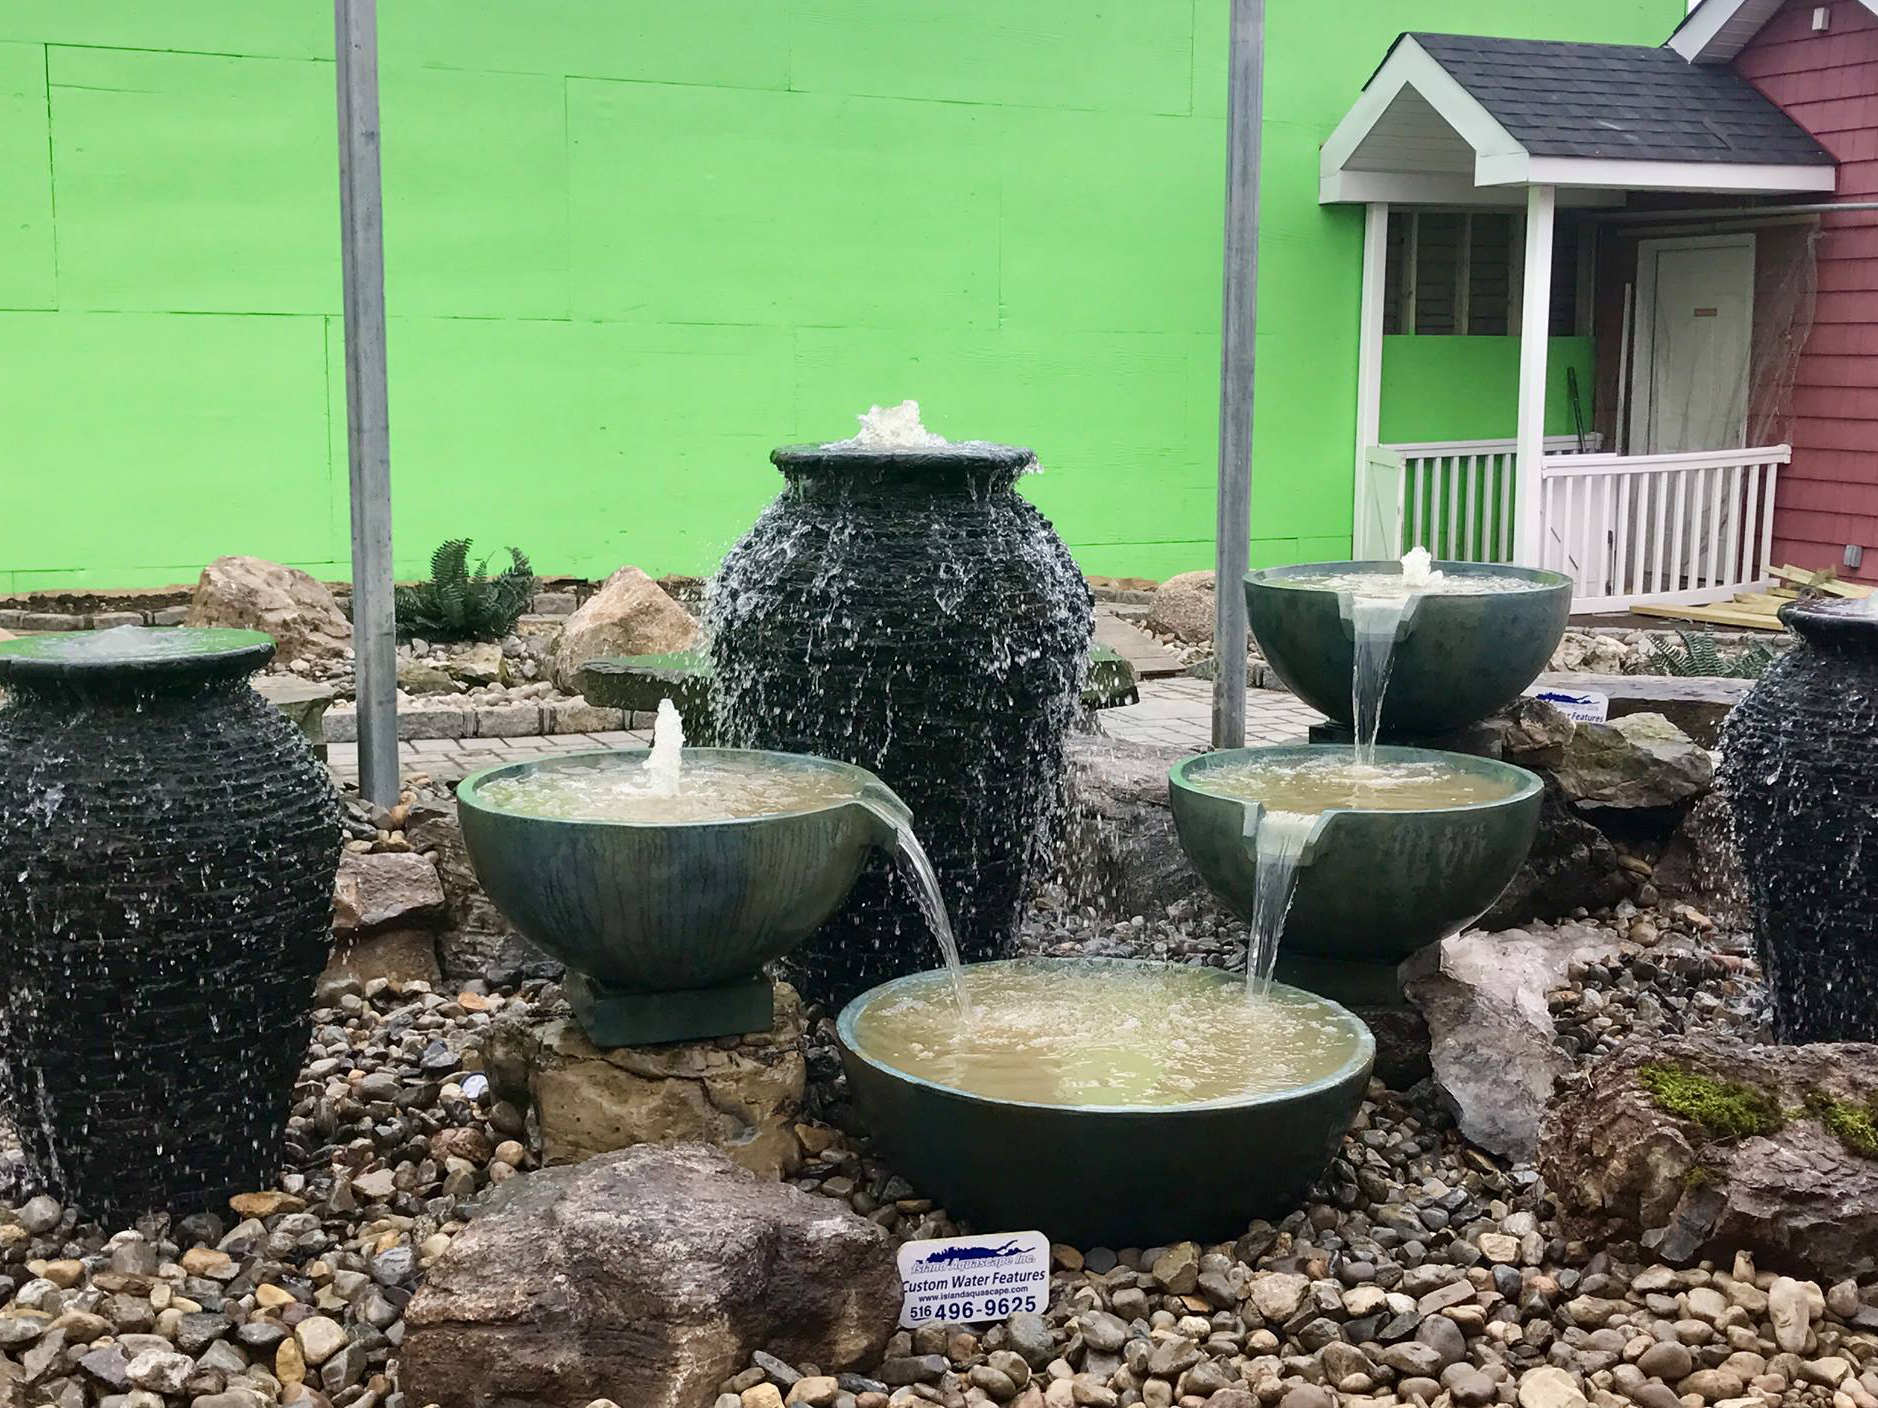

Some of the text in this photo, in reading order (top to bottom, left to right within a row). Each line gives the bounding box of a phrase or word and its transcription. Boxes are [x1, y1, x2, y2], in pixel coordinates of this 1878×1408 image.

[1571, 712, 1604, 723] Features
[948, 1255, 1013, 1271] Aquascape
[902, 1270, 1046, 1294] Custom Water Features
[918, 1285, 1029, 1303] www.islandaquascape.com
[910, 1295, 1037, 1321] 516 496-9625
